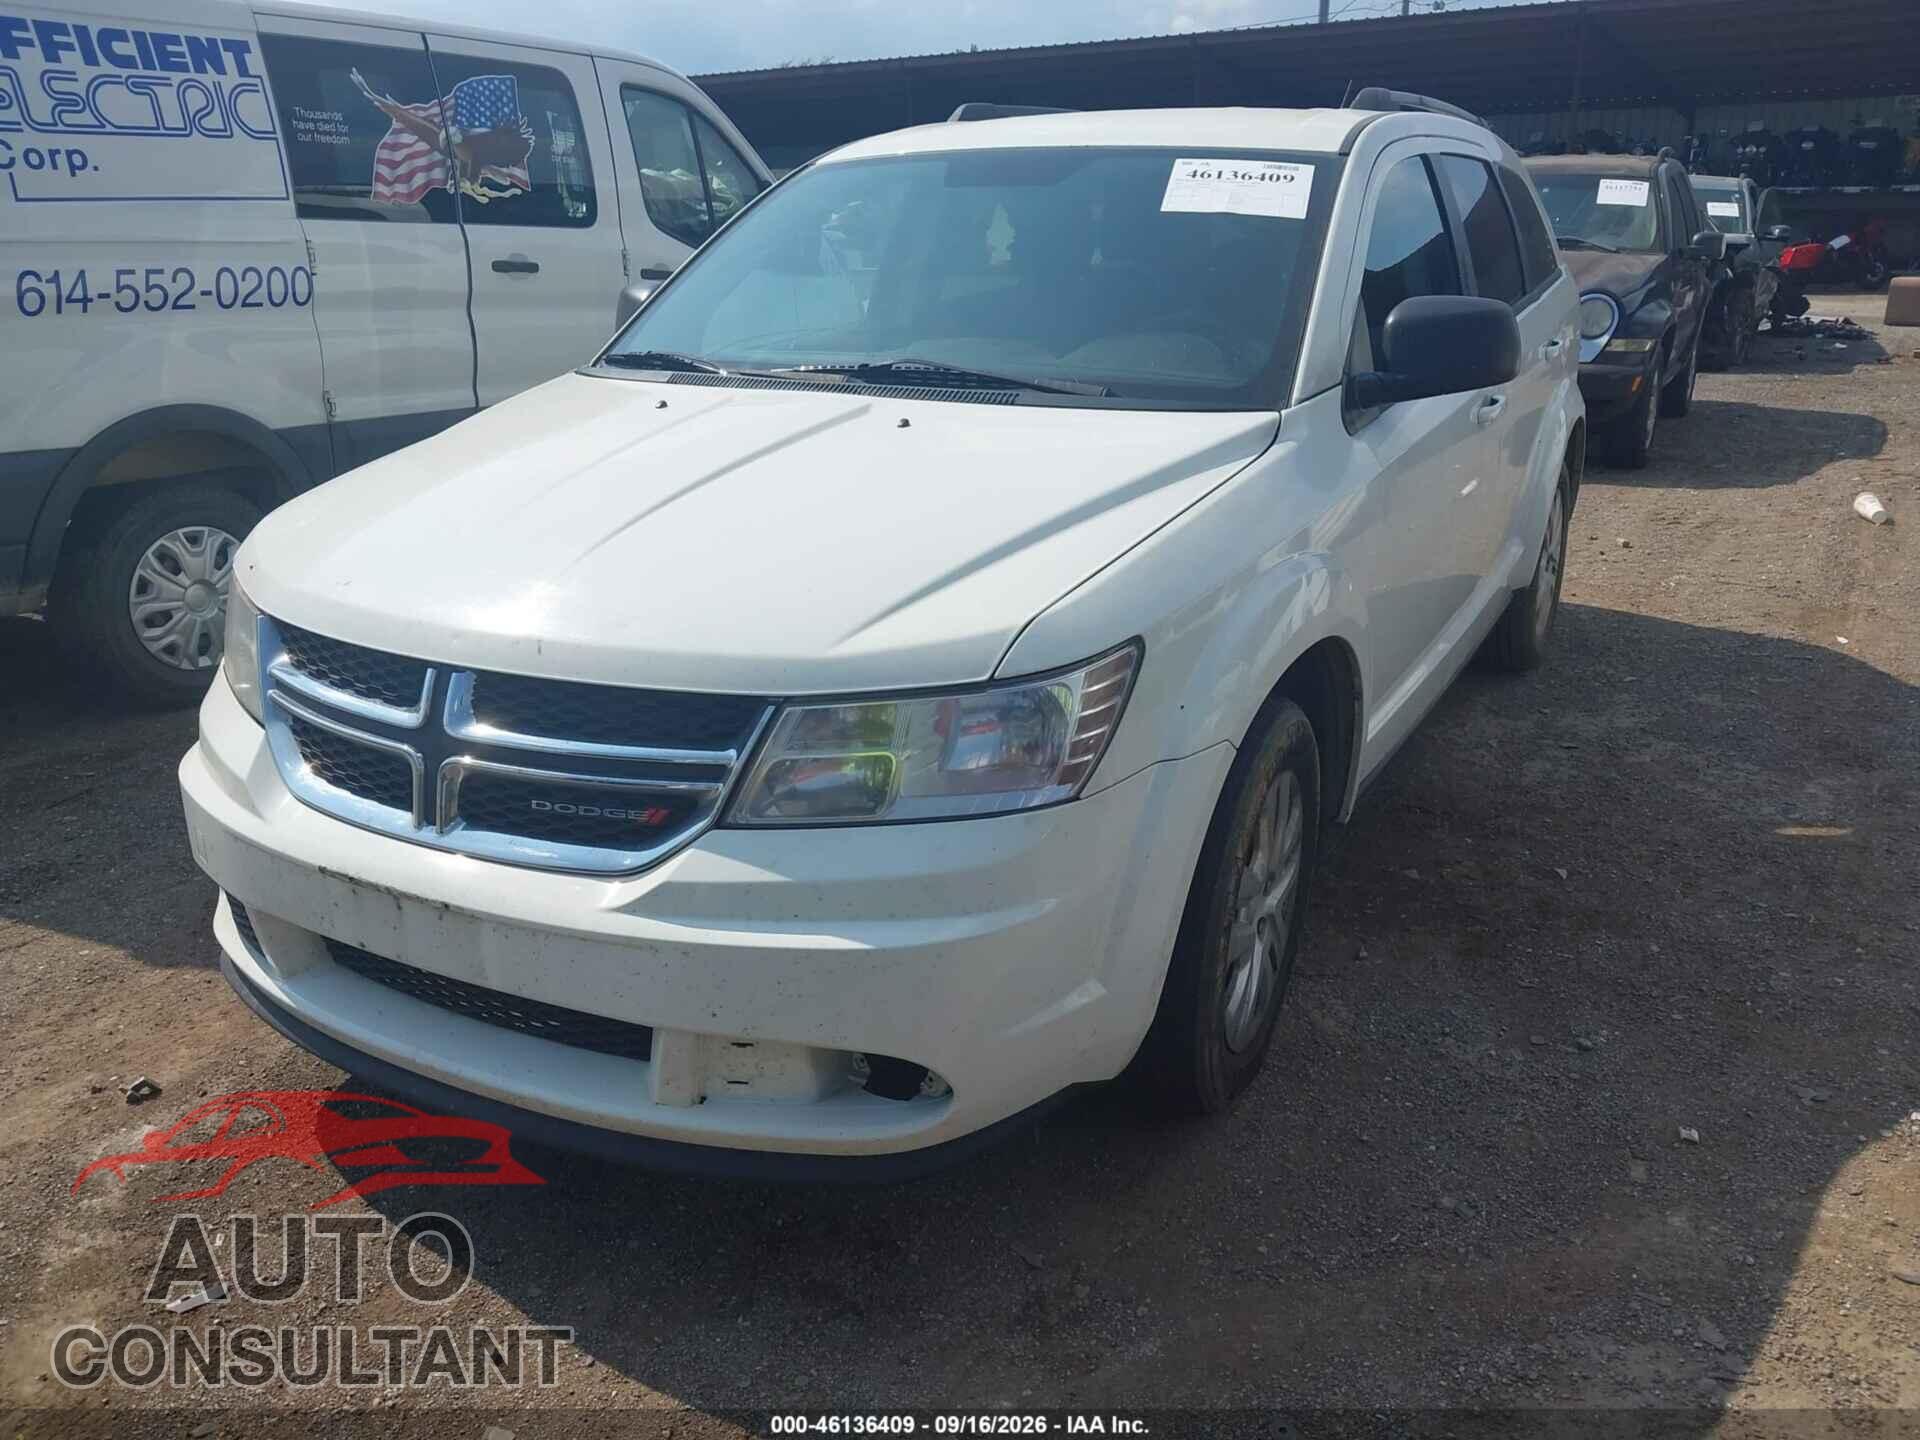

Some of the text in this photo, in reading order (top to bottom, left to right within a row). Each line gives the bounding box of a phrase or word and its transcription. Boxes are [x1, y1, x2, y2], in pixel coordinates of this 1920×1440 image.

[292, 106, 343, 121] Thousands
[292, 119, 316, 130] have
[313, 131, 350, 145] freedom
[1185, 169, 1296, 184] 46136409
[16, 266, 313, 317] 614-552-0200
[531, 800, 649, 822] DODGE
